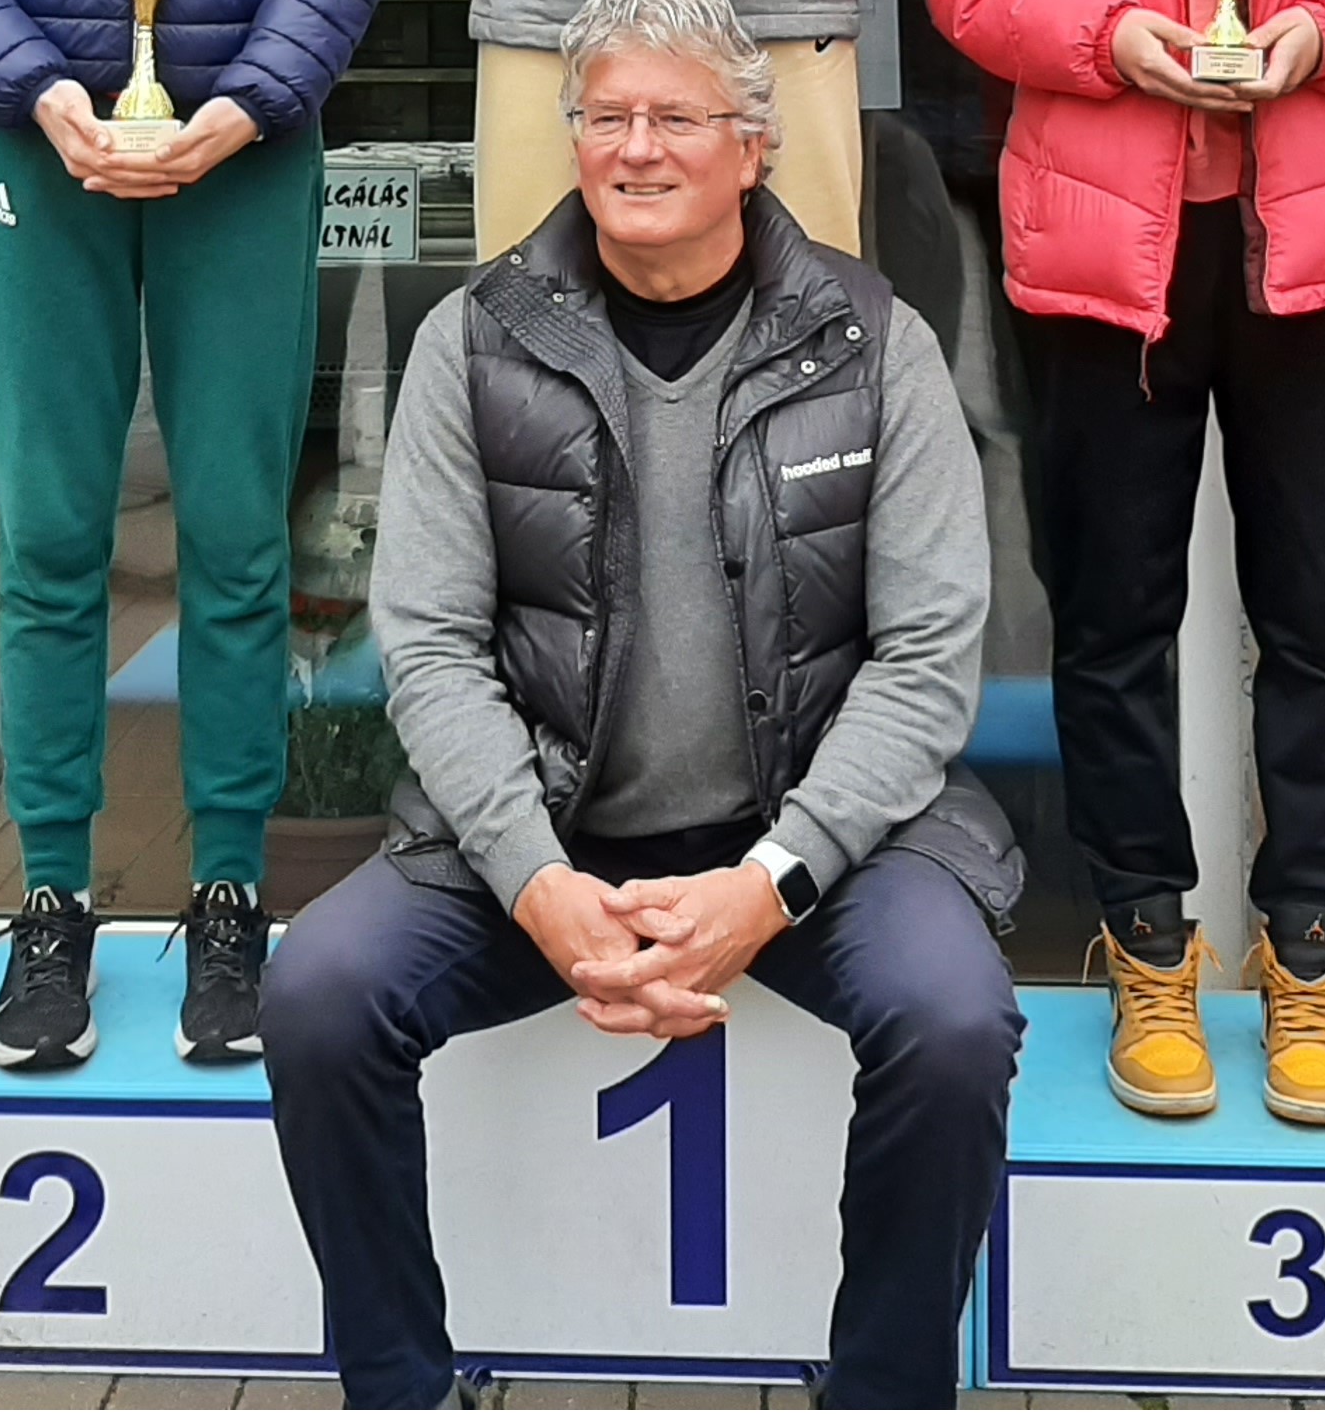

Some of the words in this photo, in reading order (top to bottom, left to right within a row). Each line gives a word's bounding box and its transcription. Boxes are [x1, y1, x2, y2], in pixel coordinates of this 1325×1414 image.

[780, 452, 841, 482] hooded
[843, 447, 874, 467] staff
[596, 1020, 727, 1306] 1
